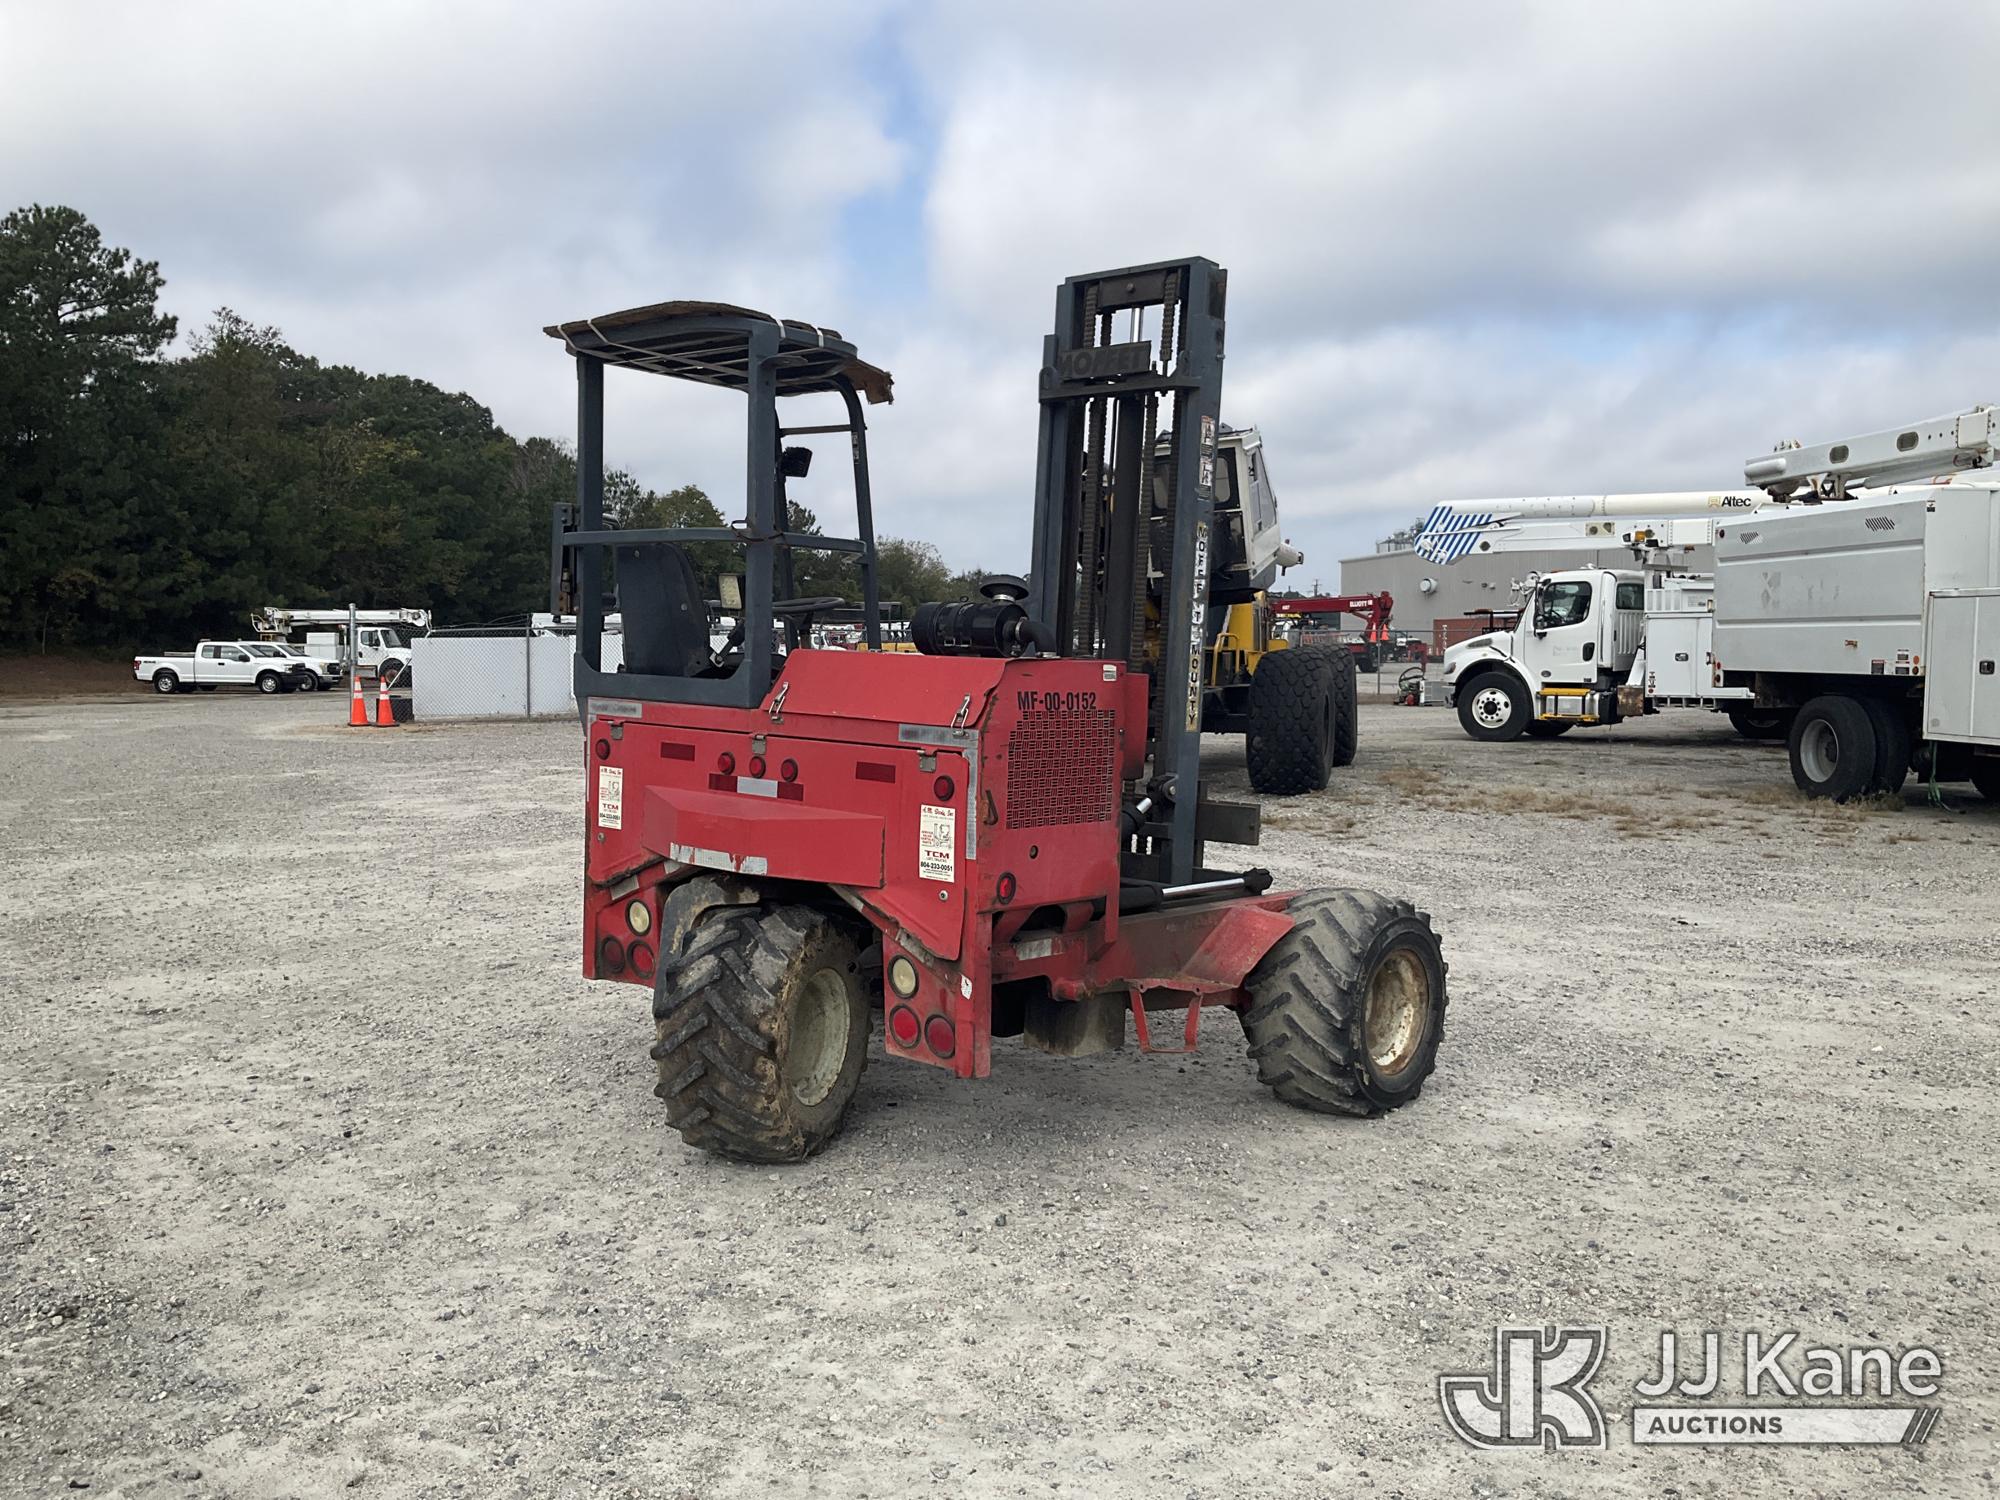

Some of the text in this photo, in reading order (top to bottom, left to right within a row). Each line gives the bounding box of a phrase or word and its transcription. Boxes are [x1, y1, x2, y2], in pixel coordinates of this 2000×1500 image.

[1721, 496, 1752, 507] Altec
[1188, 645, 1201, 726] MOUNTY
[1017, 691, 1097, 711] MF-00-0152
[924, 850, 950, 859] TCM
[920, 861, 953, 872] 804-233-0051
